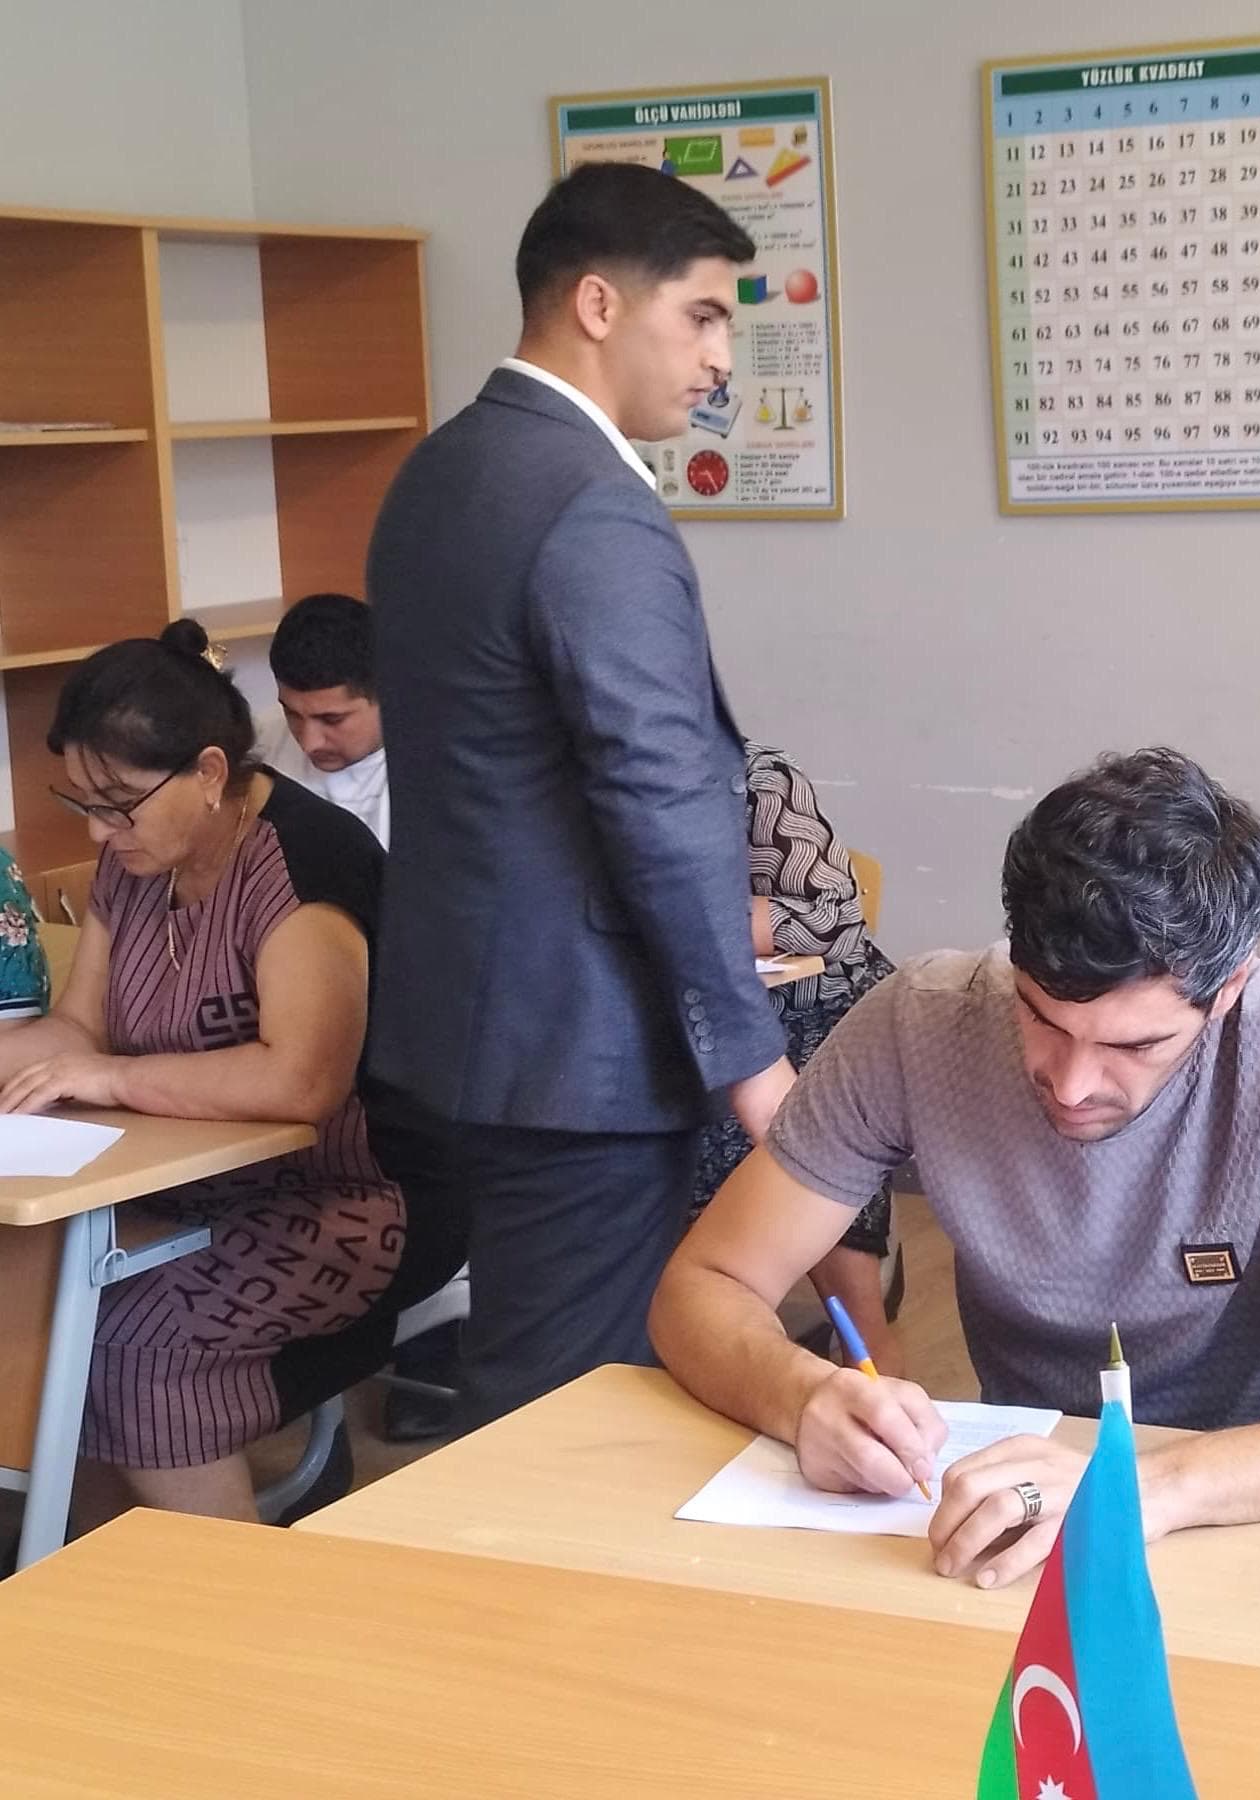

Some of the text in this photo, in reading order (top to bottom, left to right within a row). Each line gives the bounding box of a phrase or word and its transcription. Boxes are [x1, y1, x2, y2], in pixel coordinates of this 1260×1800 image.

[1139, 59, 1205, 82] KVADRAT
[635, 100, 741, 126] ÖLÇÜ VAHİDLƏRİ
[1035, 109, 1043, 125] 2
[1065, 107, 1073, 121] 3
[1094, 104, 1102, 120] 4
[1123, 102, 1133, 114] 5
[1148, 102, 1159, 114] 6
[1179, 97, 1189, 112] 7
[1210, 95, 1220, 110] 8
[1240, 93, 1251, 106] 9
[1007, 146, 1019, 161] 11
[1031, 144, 1045, 160] 12
[1060, 143, 1074, 158] 13
[1089, 140, 1104, 156] 14
[1119, 138, 1134, 153] 15
[1149, 136, 1165, 151] 16
[1179, 133, 1195, 149] 17
[1210, 131, 1226, 146] 18
[1241, 129, 1257, 144] 19
[1007, 183, 1021, 198] 21
[1031, 181, 1046, 196] 22
[1060, 178, 1076, 195] 23
[1089, 176, 1105, 192] 24
[1119, 175, 1136, 190] 25
[1149, 172, 1166, 188] 26
[1179, 169, 1196, 186] 27
[1210, 168, 1227, 184] 28
[1240, 166, 1258, 182] 29
[1008, 220, 1022, 235] 31
[1032, 218, 1048, 234] 32
[1061, 216, 1077, 230] 33
[1091, 215, 1106, 229] 34
[1120, 212, 1137, 226] 35
[1150, 211, 1167, 225] 36
[1180, 208, 1197, 223] 37
[1211, 207, 1227, 221] 38
[1241, 205, 1258, 219] 39
[1009, 255, 1023, 268] 41
[1033, 253, 1049, 268] 42
[1062, 251, 1078, 265] 43
[1091, 249, 1107, 264] 44
[1120, 247, 1138, 262] 45
[1150, 246, 1168, 260] 46
[1181, 243, 1197, 258] 47
[1211, 242, 1228, 257] 48
[1242, 240, 1259, 254] 49
[1010, 290, 1025, 305] 51
[1035, 288, 1051, 304] 52
[1063, 287, 1080, 300] 53
[1093, 285, 1109, 299] 54
[1122, 283, 1139, 295] 55
[1151, 282, 1169, 296] 56
[1181, 280, 1198, 294] 57
[1212, 279, 1229, 292] 58
[1242, 276, 1260, 291] 59
[1012, 327, 1026, 341] 61
[1036, 325, 1052, 340] 62
[1064, 324, 1081, 338] 63
[1094, 323, 1110, 337] 64
[1122, 321, 1140, 336] 65
[1152, 320, 1170, 334] 66
[1182, 318, 1199, 332] 67
[1212, 317, 1230, 331] 68
[1242, 316, 1260, 329] 69
[1013, 361, 1028, 376] 71
[1038, 360, 1054, 375] 72
[1066, 359, 1082, 372] 73
[1095, 357, 1111, 372] 74
[1124, 356, 1141, 369] 75
[1154, 355, 1171, 369] 76
[1183, 353, 1200, 368] 77
[1213, 352, 1231, 366] 78
[1243, 351, 1260, 365] 79
[1015, 398, 1030, 412] 81
[1039, 396, 1054, 411] 82
[1067, 395, 1084, 409] 83
[1096, 394, 1112, 408] 84
[1125, 393, 1142, 407] 85
[1155, 392, 1172, 406] 86
[1184, 390, 1201, 405] 87
[1214, 390, 1232, 404] 88
[1014, 431, 1029, 445] 91
[1042, 430, 1059, 444] 92
[1071, 429, 1087, 442] 93
[1095, 429, 1112, 442] 94
[1124, 427, 1141, 441] 95
[1153, 427, 1171, 440] 96
[1183, 425, 1200, 439] 97
[1213, 425, 1230, 438] 98
[1243, 424, 1260, 437] 99
